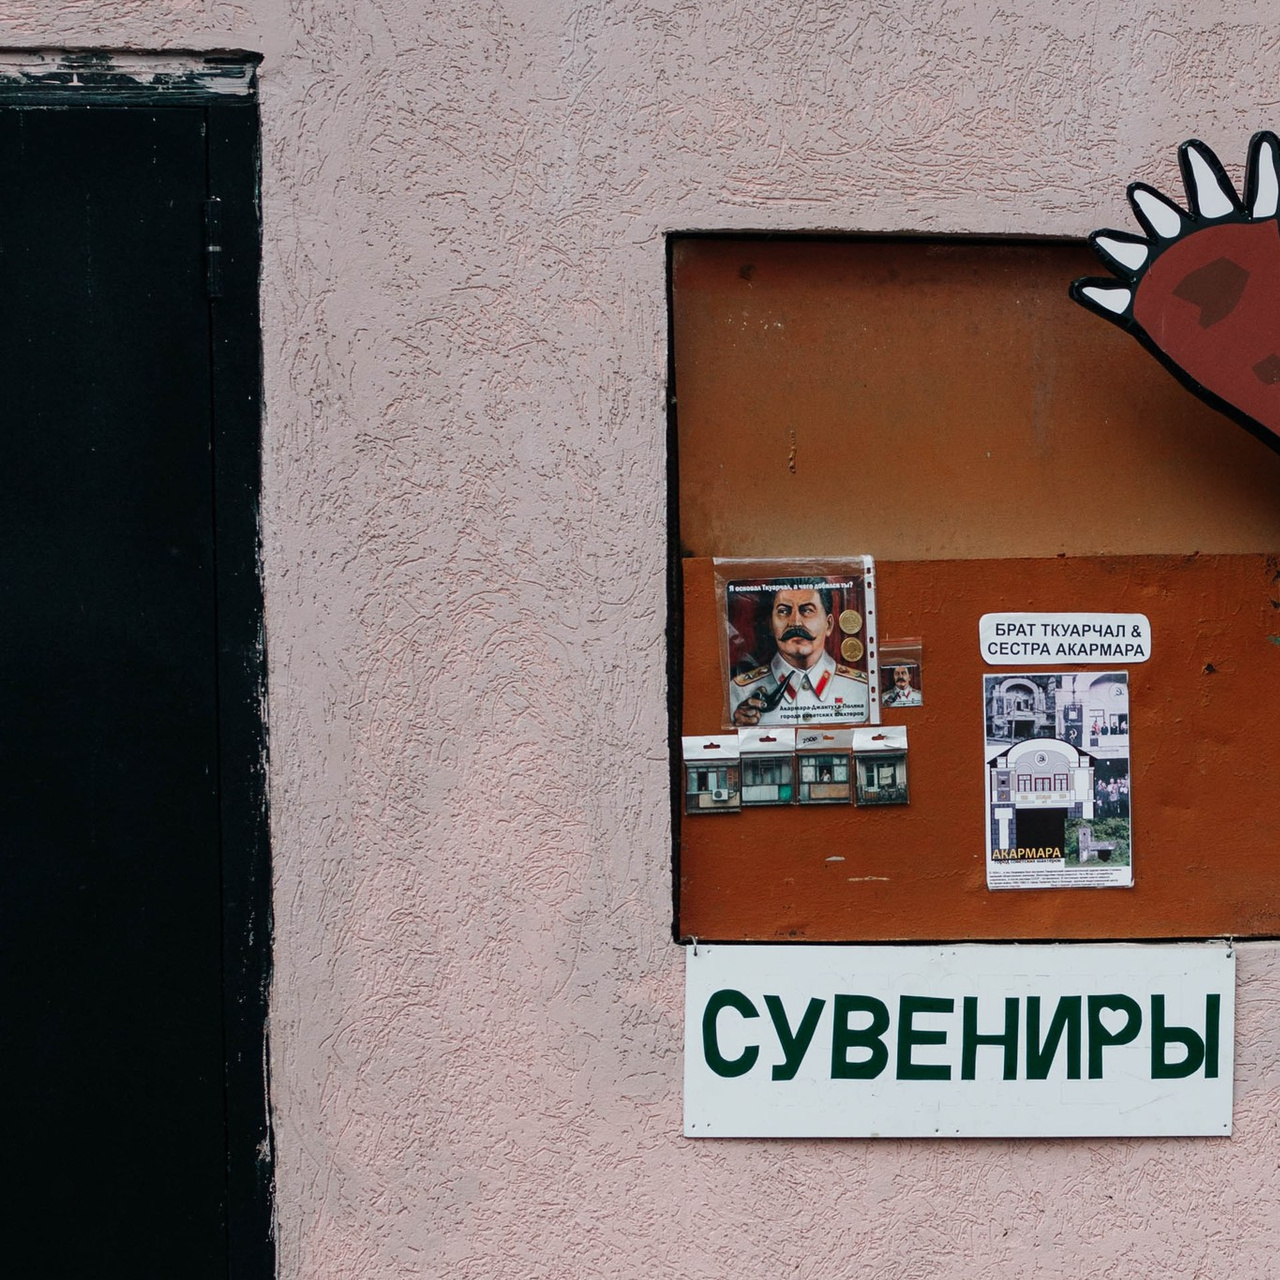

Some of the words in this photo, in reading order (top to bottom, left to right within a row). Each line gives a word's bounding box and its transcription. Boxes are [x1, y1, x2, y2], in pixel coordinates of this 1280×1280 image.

[995, 623, 1036, 637] БРАТ
[1040, 623, 1126, 638] ТКУАРЧАЛ
[1131, 624, 1142, 638] &
[987, 642, 1051, 656] СЕСТРА
[1055, 642, 1145, 657] АКАРМАРА
[992, 847, 1061, 859] АКАРМАРА
[702, 988, 1221, 1082] СУВЕНИРЫ
